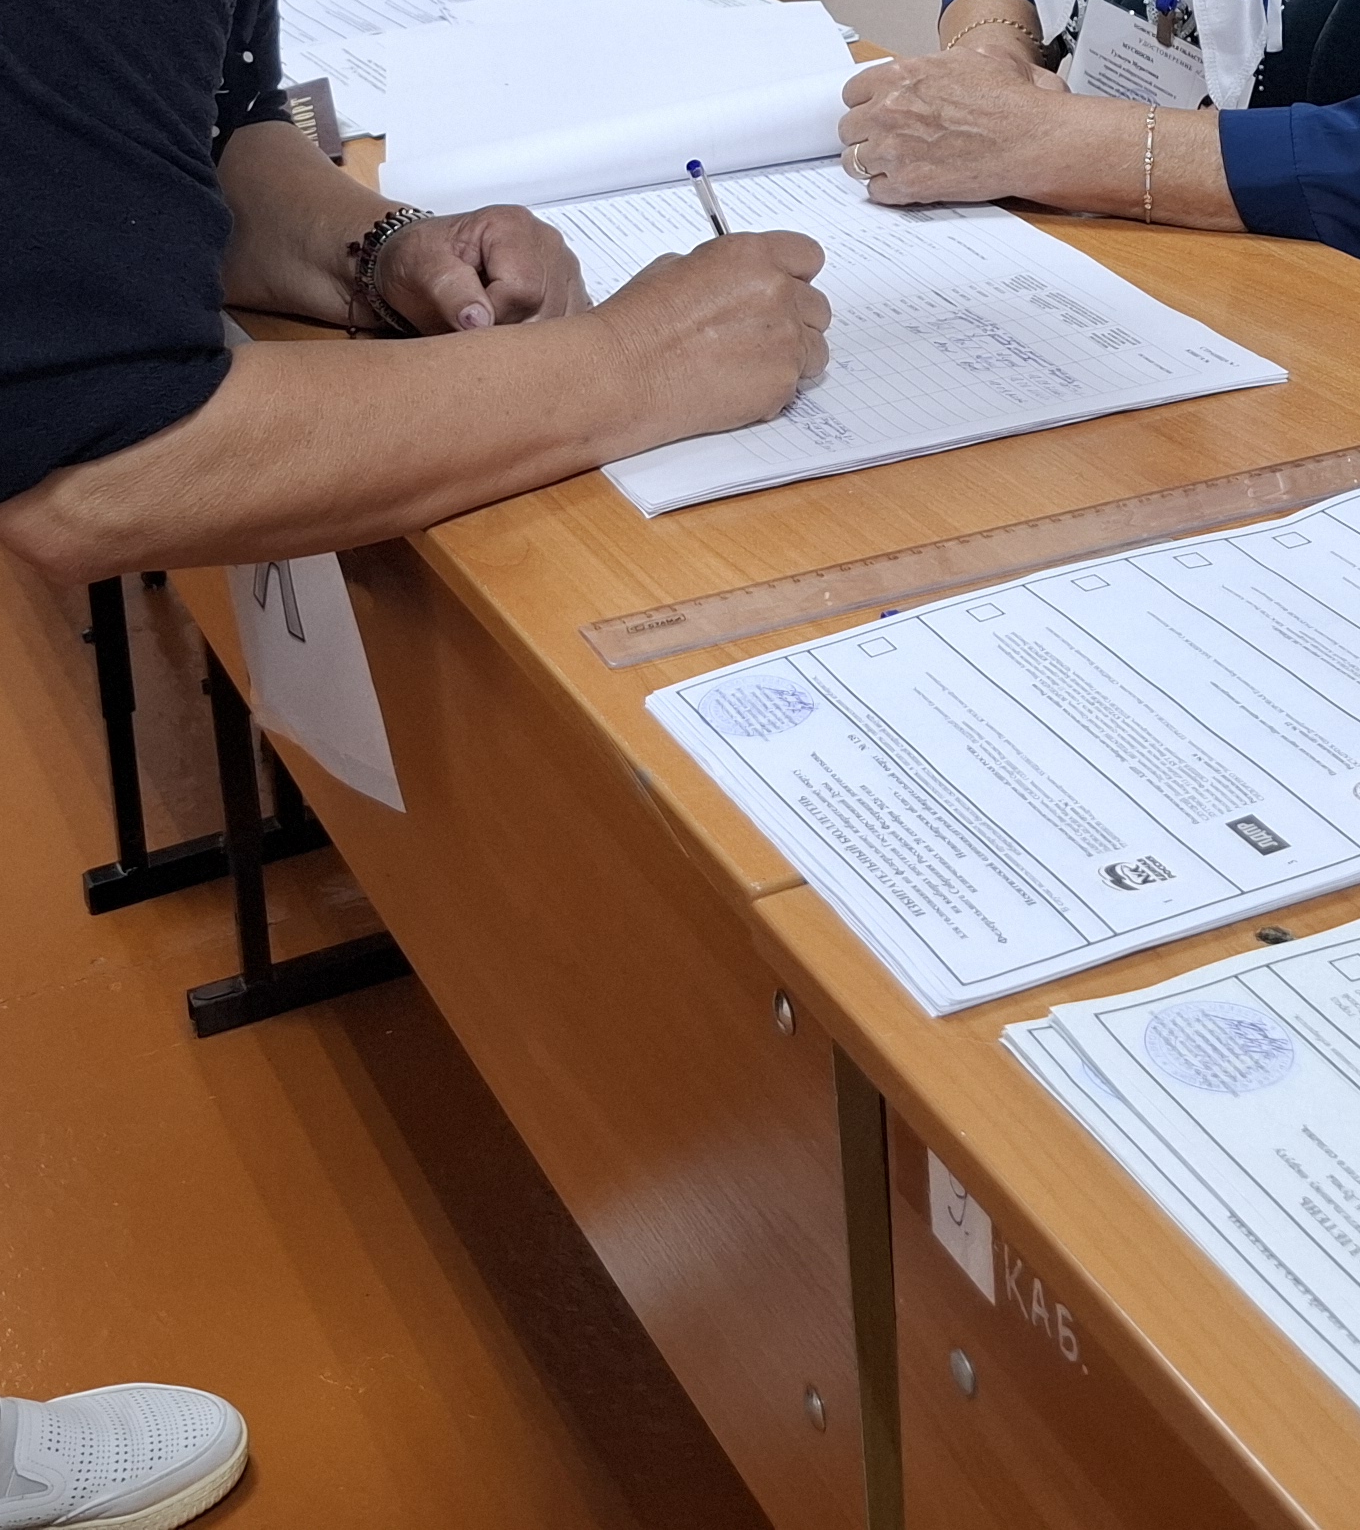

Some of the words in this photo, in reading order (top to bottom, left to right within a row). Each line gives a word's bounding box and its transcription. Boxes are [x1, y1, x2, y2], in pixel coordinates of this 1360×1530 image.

[797, 795, 852, 844] БЮЛЛЕТЕНЬ
[1230, 816, 1285, 851] ЛДПР
[843, 843, 926, 917] ИЗБИРАТЕЛЬНЫЙ
[1004, 1244, 1089, 1376] КАБ.
